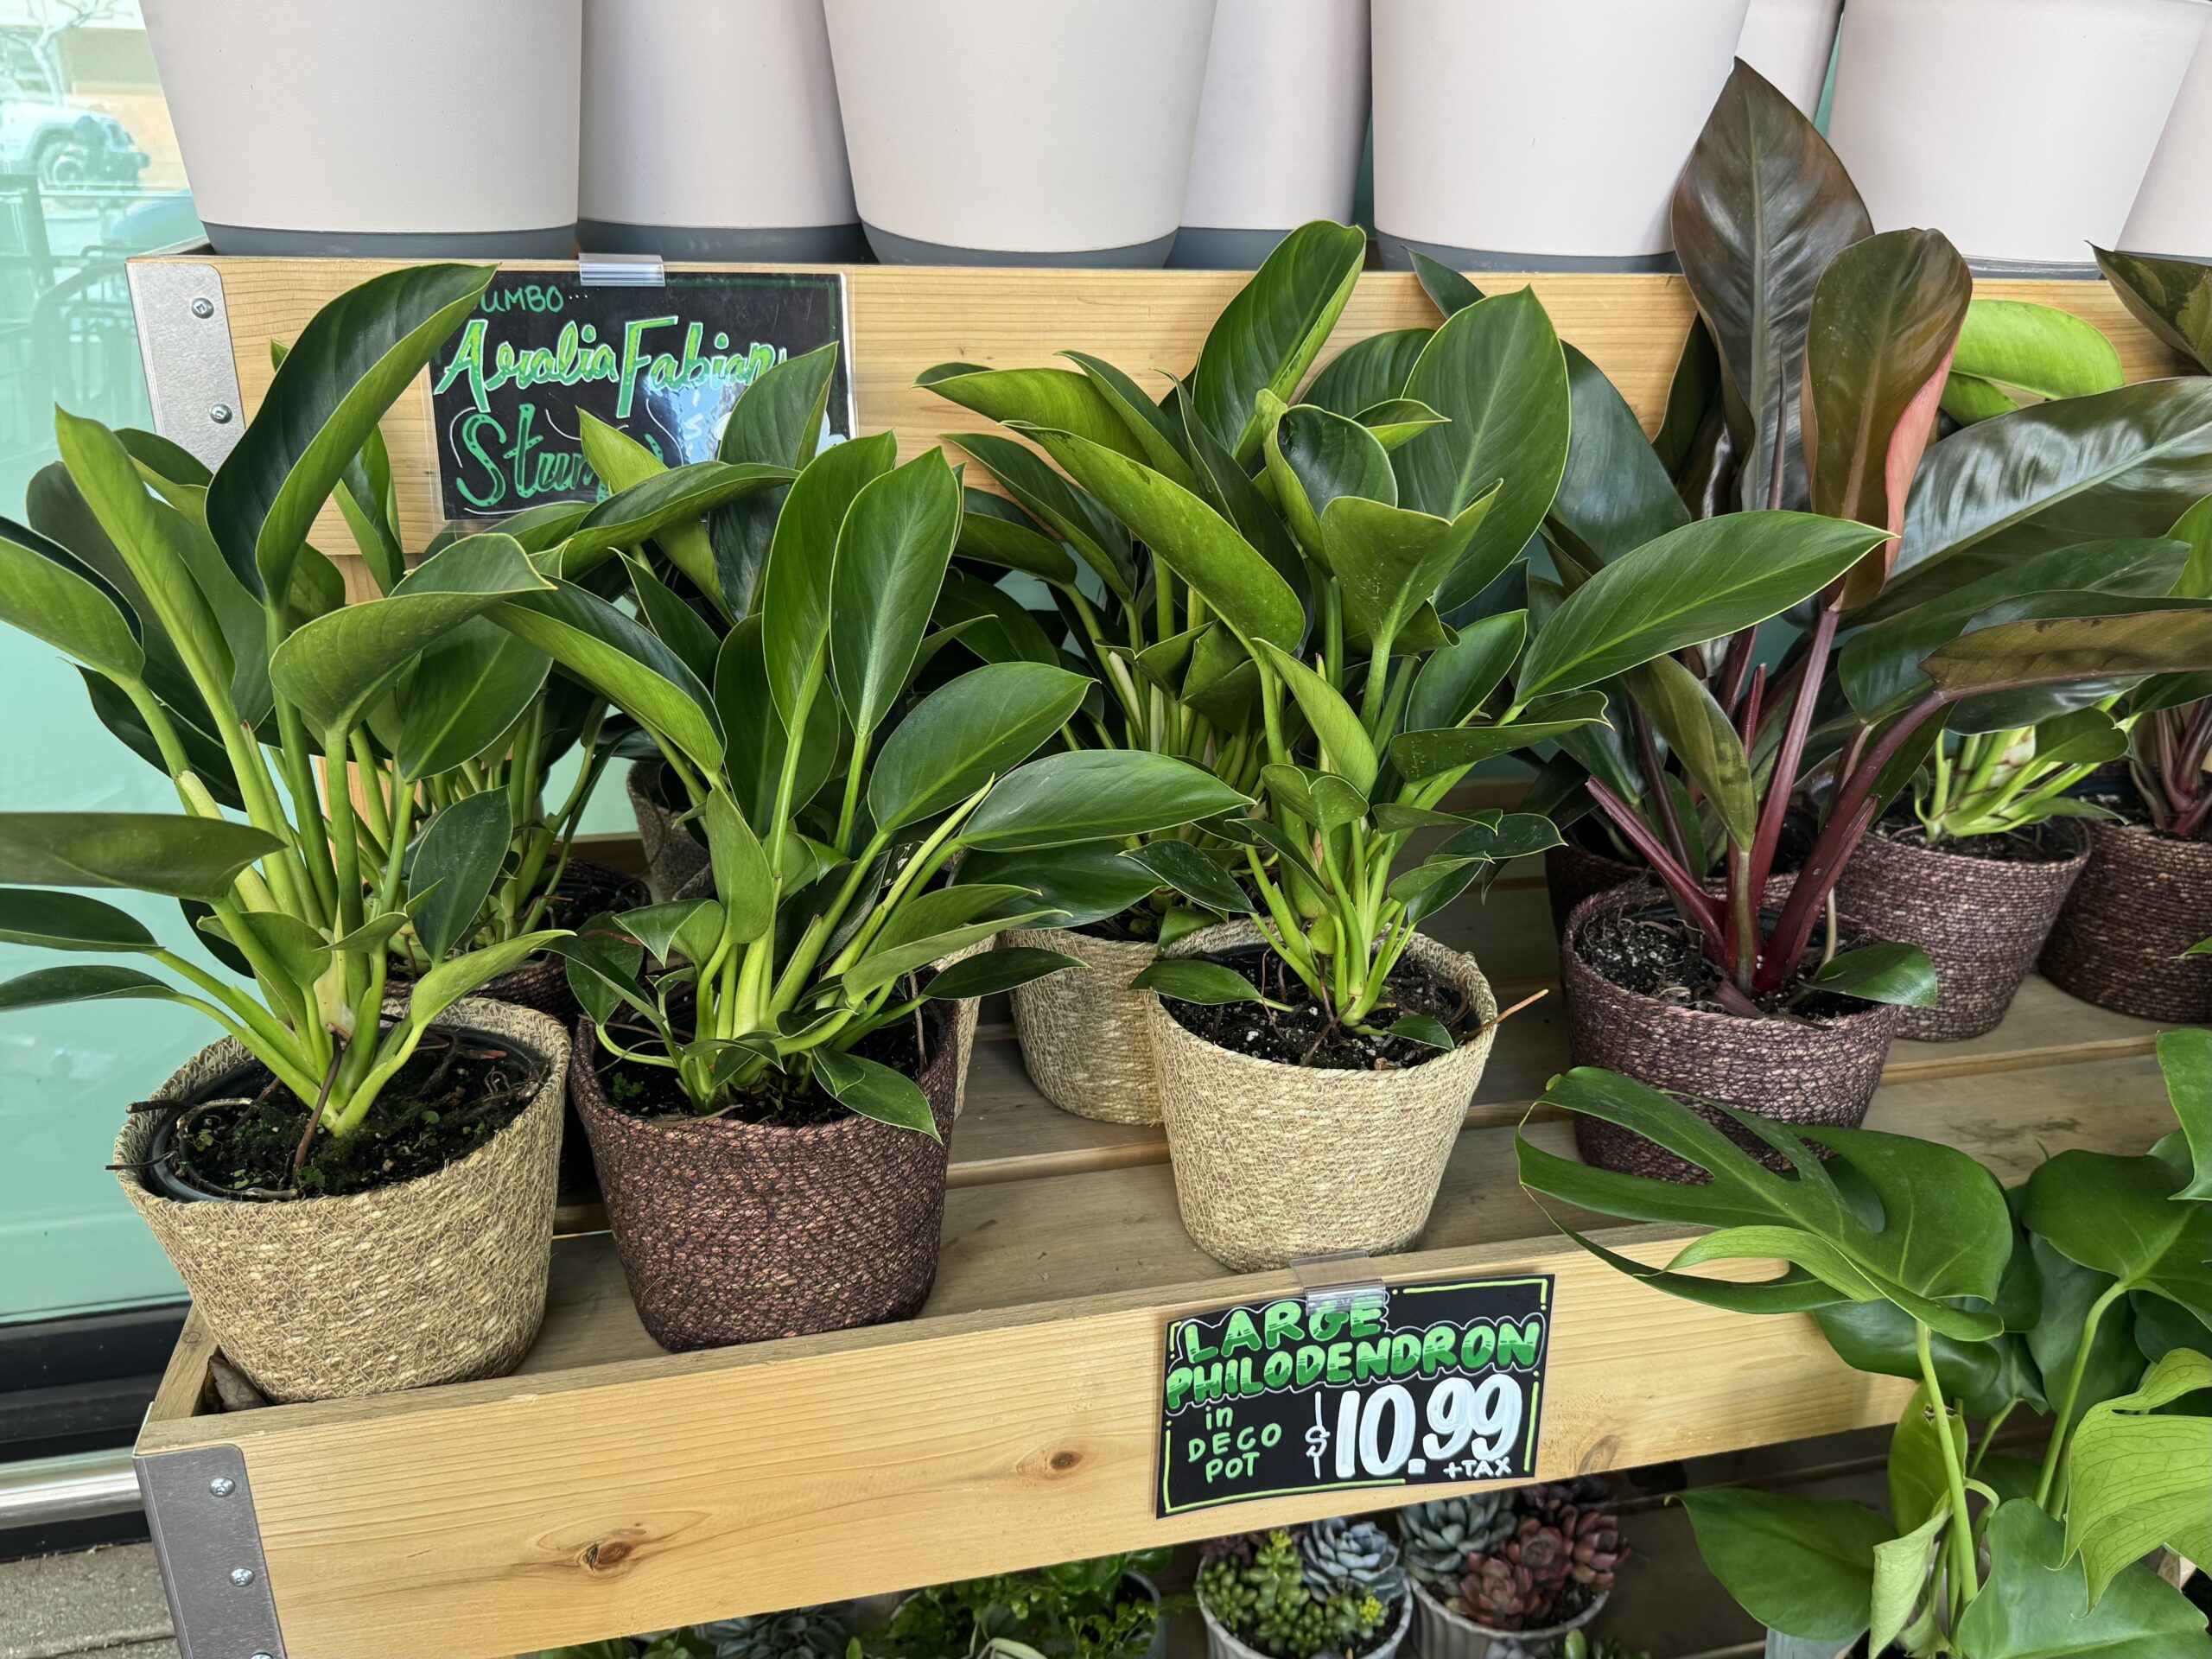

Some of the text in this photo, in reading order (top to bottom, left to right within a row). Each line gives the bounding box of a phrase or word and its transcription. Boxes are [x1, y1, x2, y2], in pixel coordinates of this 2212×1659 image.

[480, 284, 564, 313] UMBO
[1184, 1295, 1382, 1363] LARGE
[1166, 1321, 1541, 1410] PHILODENDRON
[1205, 1405, 1234, 1431] in
[1304, 1373, 1523, 1480] $10.99
[1187, 1422, 1283, 1463] DECO
[1205, 1451, 1261, 1484] POT
[1443, 1456, 1513, 1480] +TAX
